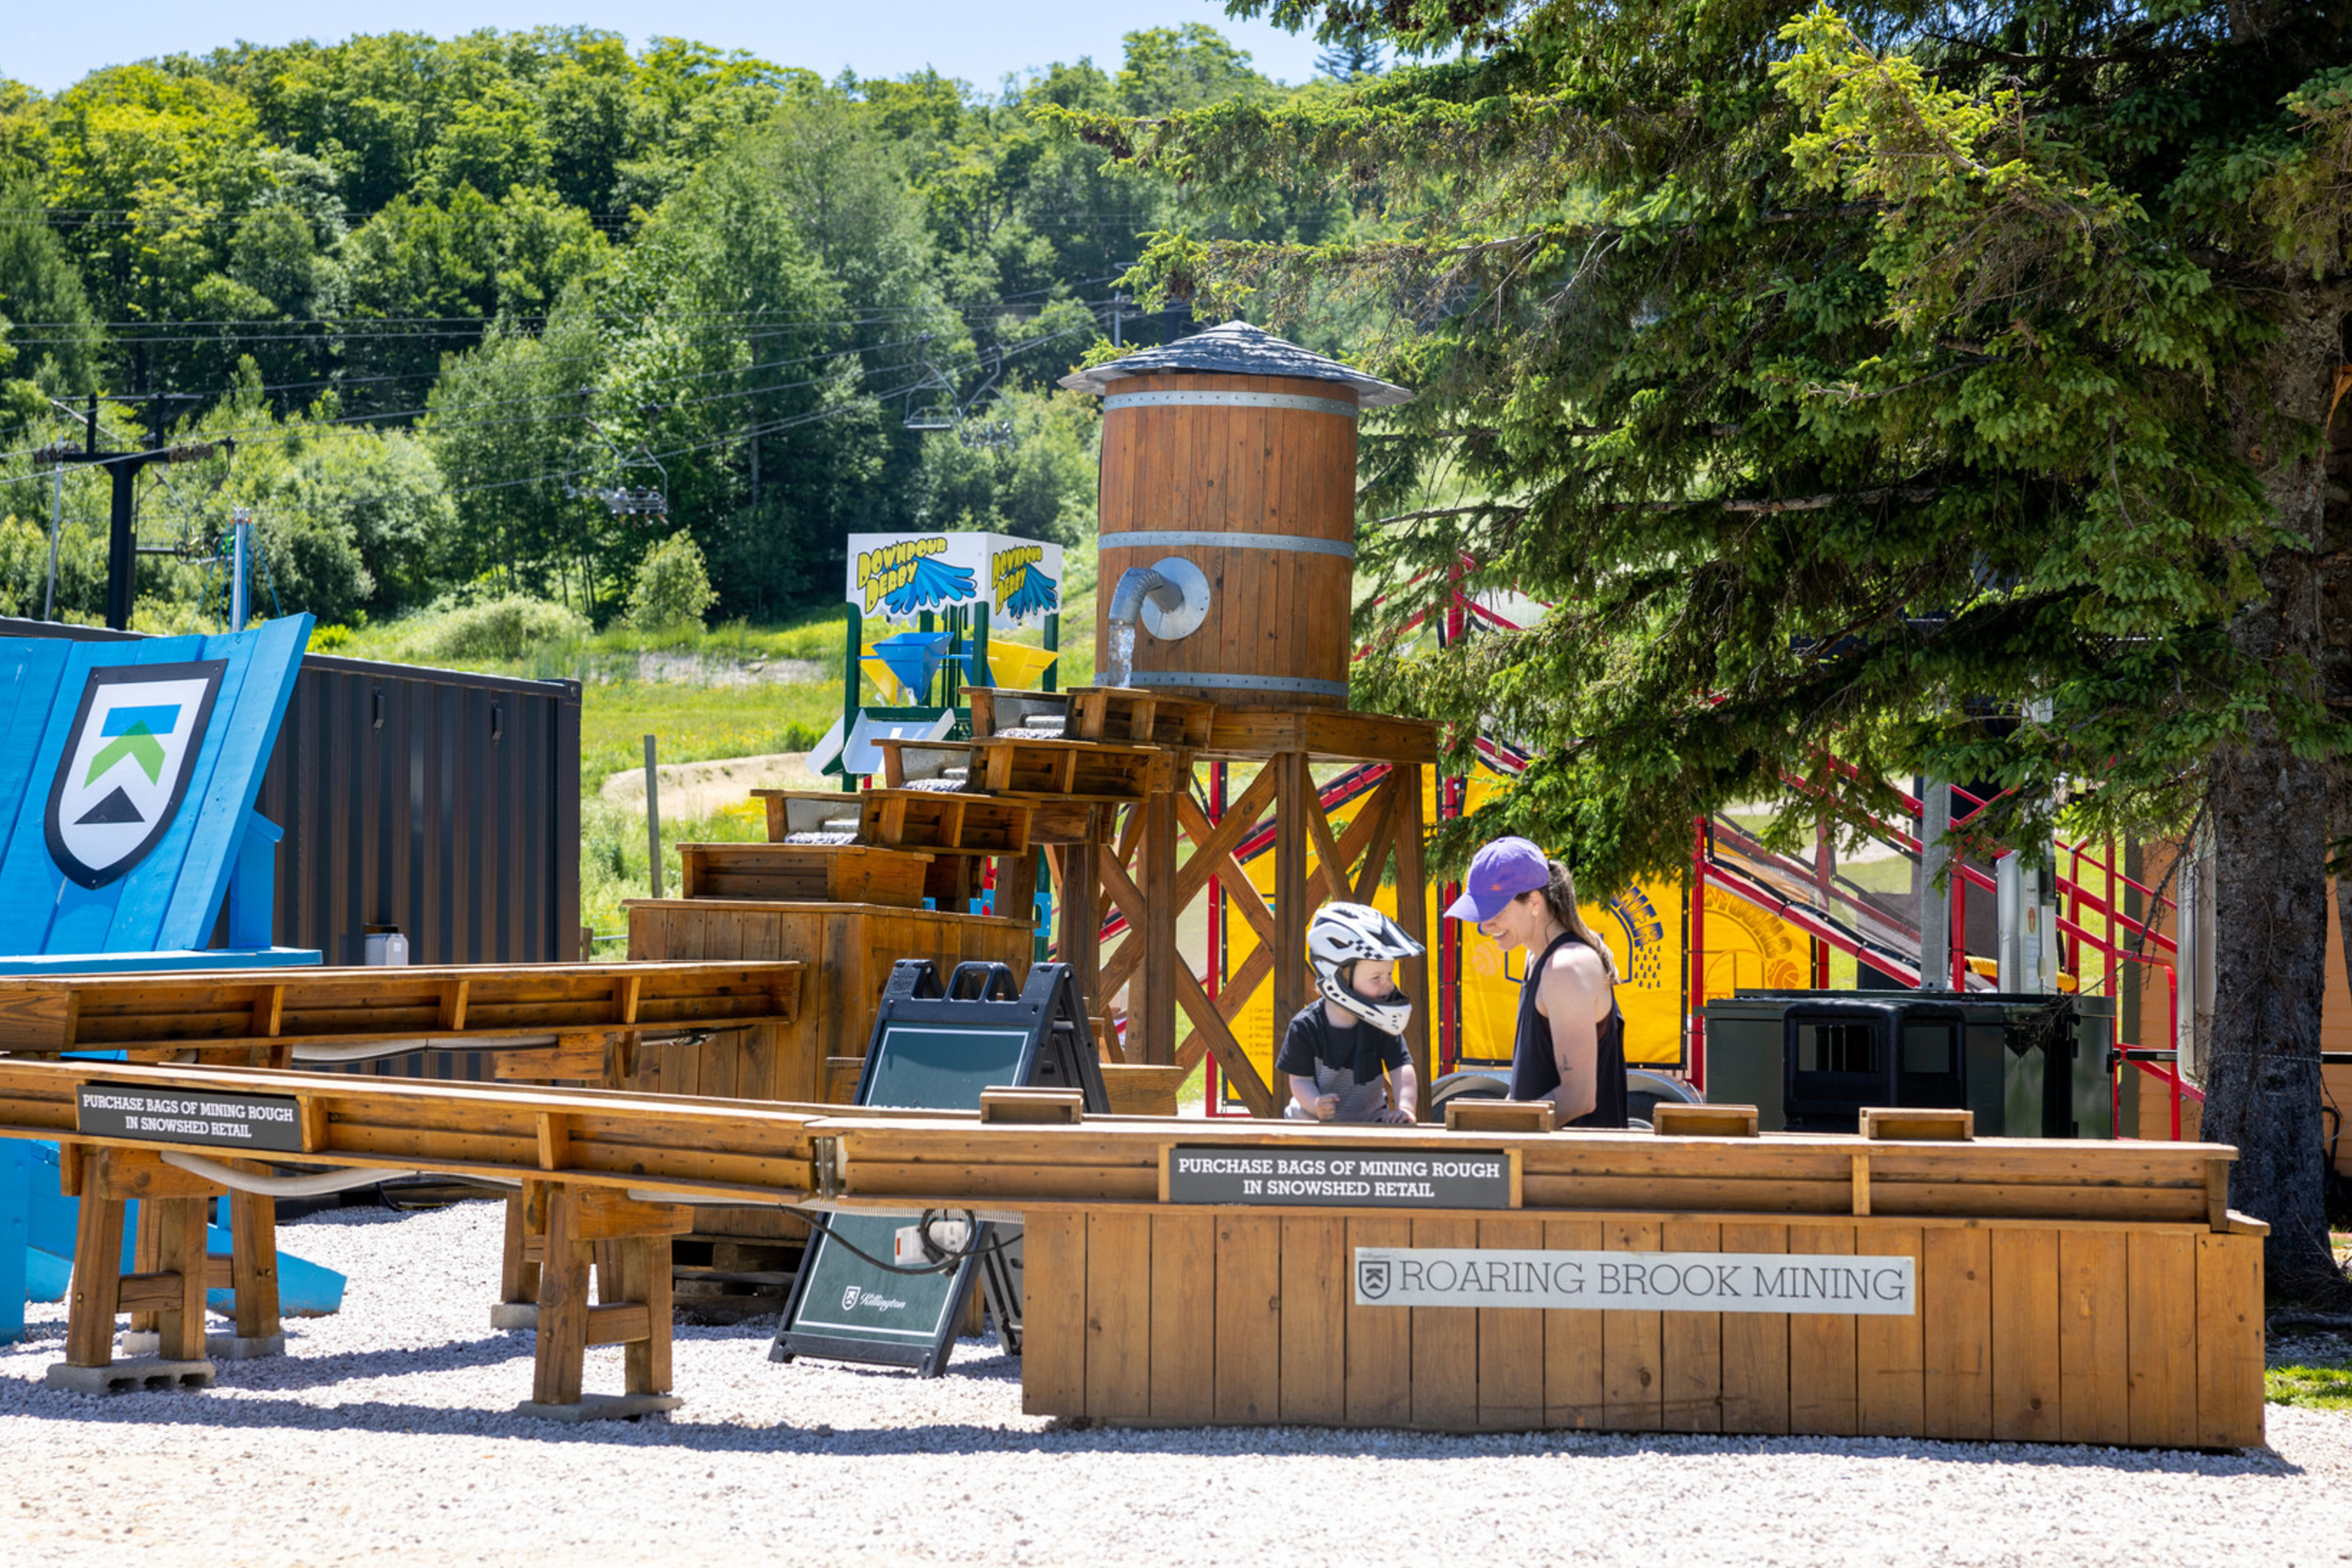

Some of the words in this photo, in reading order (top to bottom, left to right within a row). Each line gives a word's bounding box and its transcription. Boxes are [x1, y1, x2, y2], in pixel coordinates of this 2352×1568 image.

[857, 537, 947, 590] DOWNPOUR
[865, 560, 918, 615] DERBY
[83, 1094, 145, 1111] PURCHASE
[146, 1098, 179, 1114] BAGS
[181, 1101, 198, 1115] OF
[200, 1102, 246, 1118] MINING
[248, 1105, 294, 1122] ROUGH
[125, 1116, 138, 1129] IN
[140, 1117, 209, 1135] SNOWSHED
[211, 1122, 252, 1138] RETAIL
[1178, 1158, 1273, 1174] PURCHASE
[1277, 1159, 1326, 1175] BAGS
[1330, 1160, 1356, 1175] OF
[1359, 1161, 1428, 1177] MINING
[1431, 1162, 1500, 1178] ROUGH
[1243, 1179, 1263, 1195] IN
[1267, 1180, 1371, 1197] SNOWSHED
[1374, 1181, 1435, 1198] RETAIL
[1400, 1260, 1585, 1294] ROARING
[1598, 1263, 1742, 1297] BROOK
[1752, 1266, 1906, 1301] MINING
